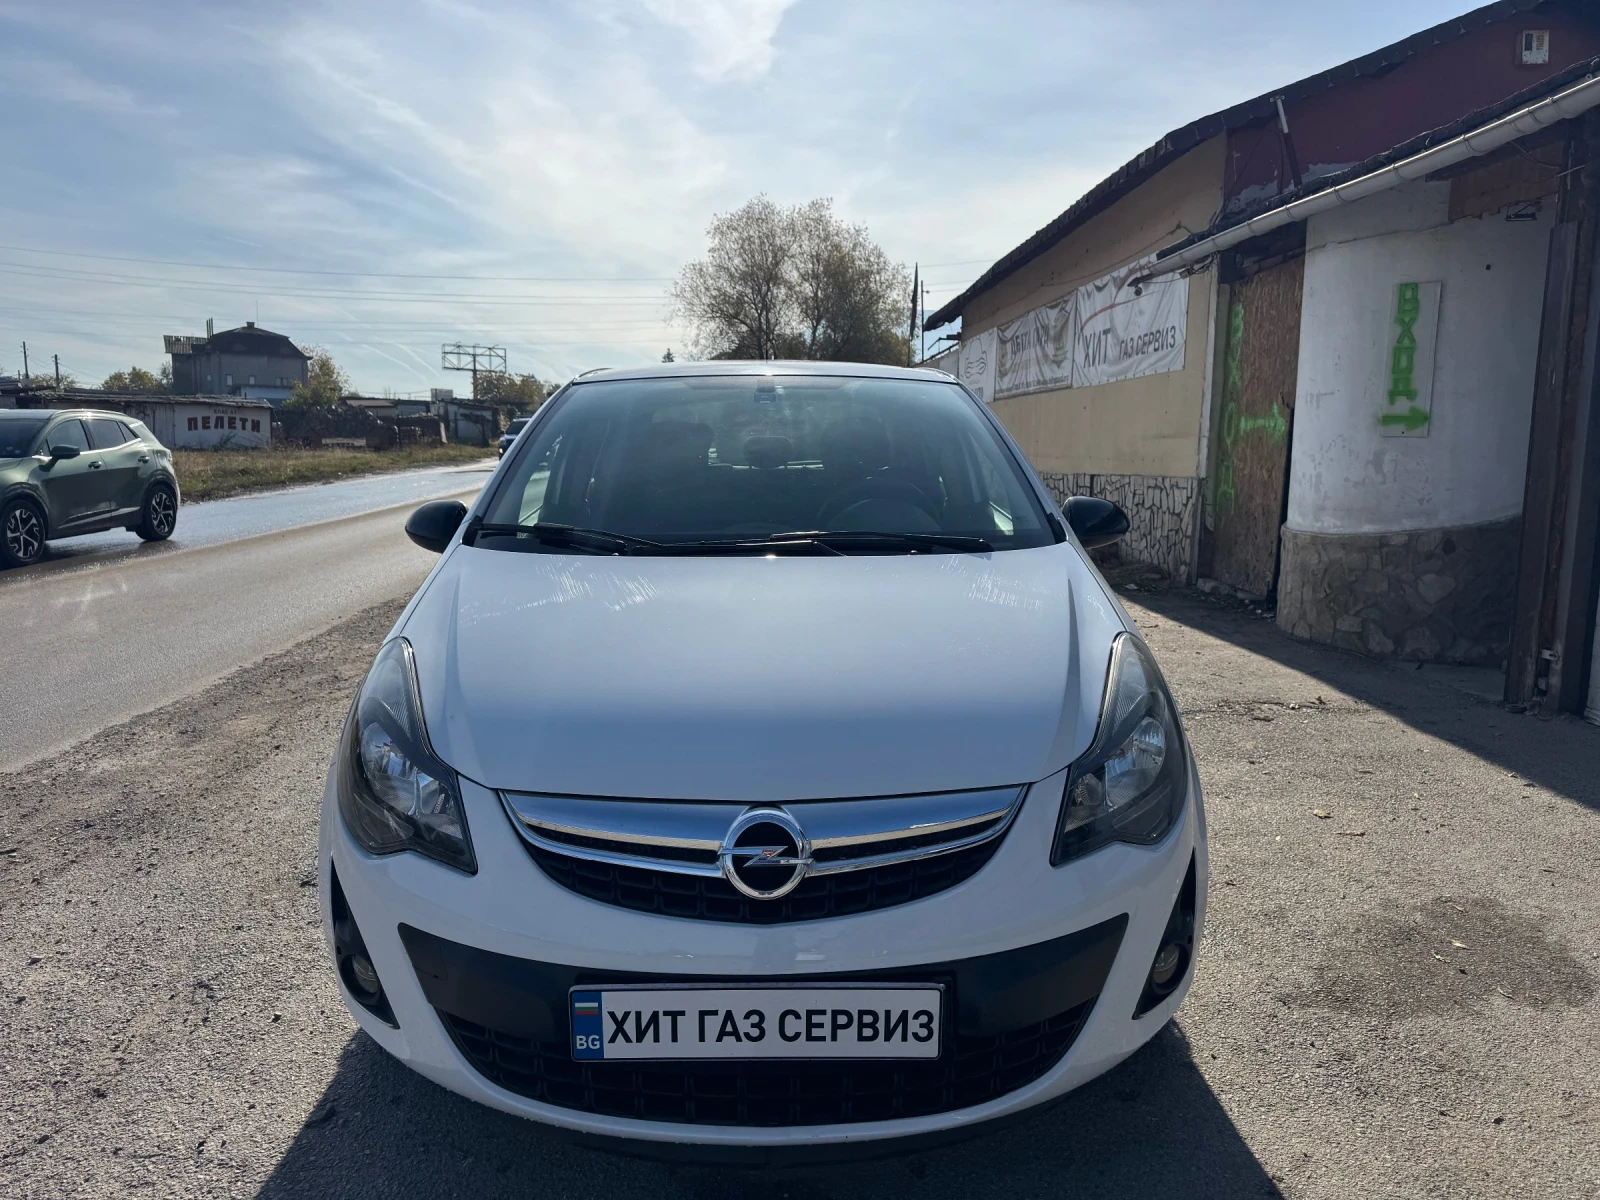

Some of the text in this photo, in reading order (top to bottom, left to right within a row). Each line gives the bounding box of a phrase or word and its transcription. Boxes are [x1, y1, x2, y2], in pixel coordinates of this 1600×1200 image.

[1083, 327, 1111, 369] ХИТ
[1118, 337, 1135, 361] ГАЗ
[1136, 325, 1177, 358] СЕРВИЗ
[1387, 283, 1420, 406] ВХОД
[187, 416, 261, 433] ПЕЛЕТИ
[575, 1034, 601, 1050] BG
[607, 1009, 935, 1044] ХИТ ГАЗ СЕРВИЗ
